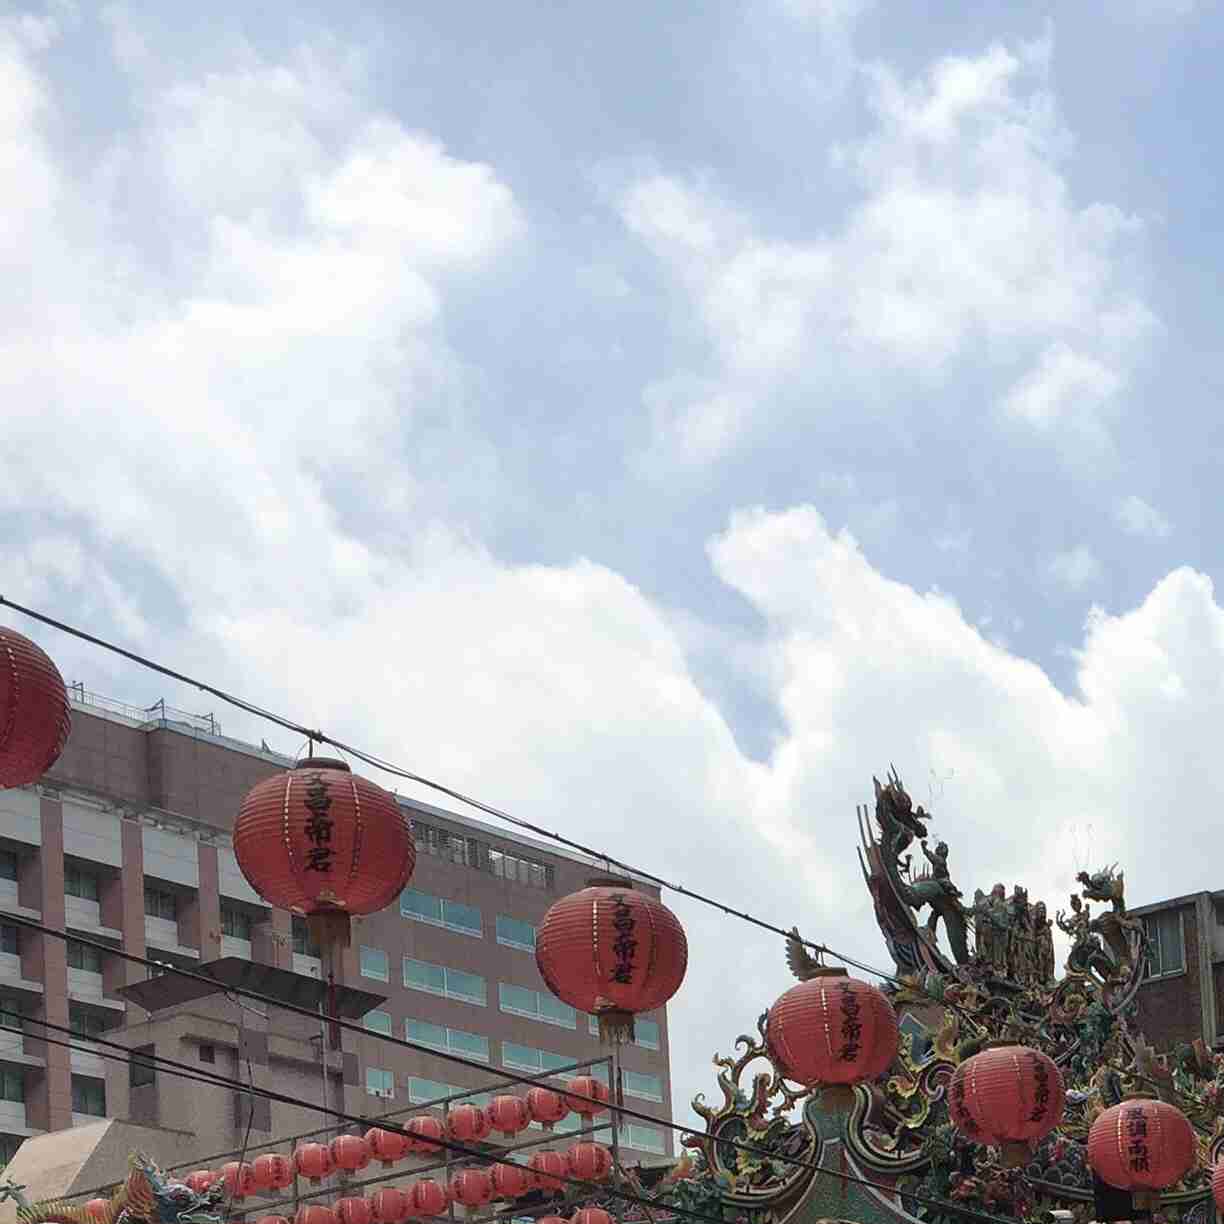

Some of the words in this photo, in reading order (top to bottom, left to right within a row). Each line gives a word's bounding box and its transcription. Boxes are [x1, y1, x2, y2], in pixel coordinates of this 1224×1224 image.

[304, 771, 336, 873] 文昌帝君
[608, 894, 639, 985] 文昌帝君
[1127, 1106, 1151, 1173] 風調雨順
